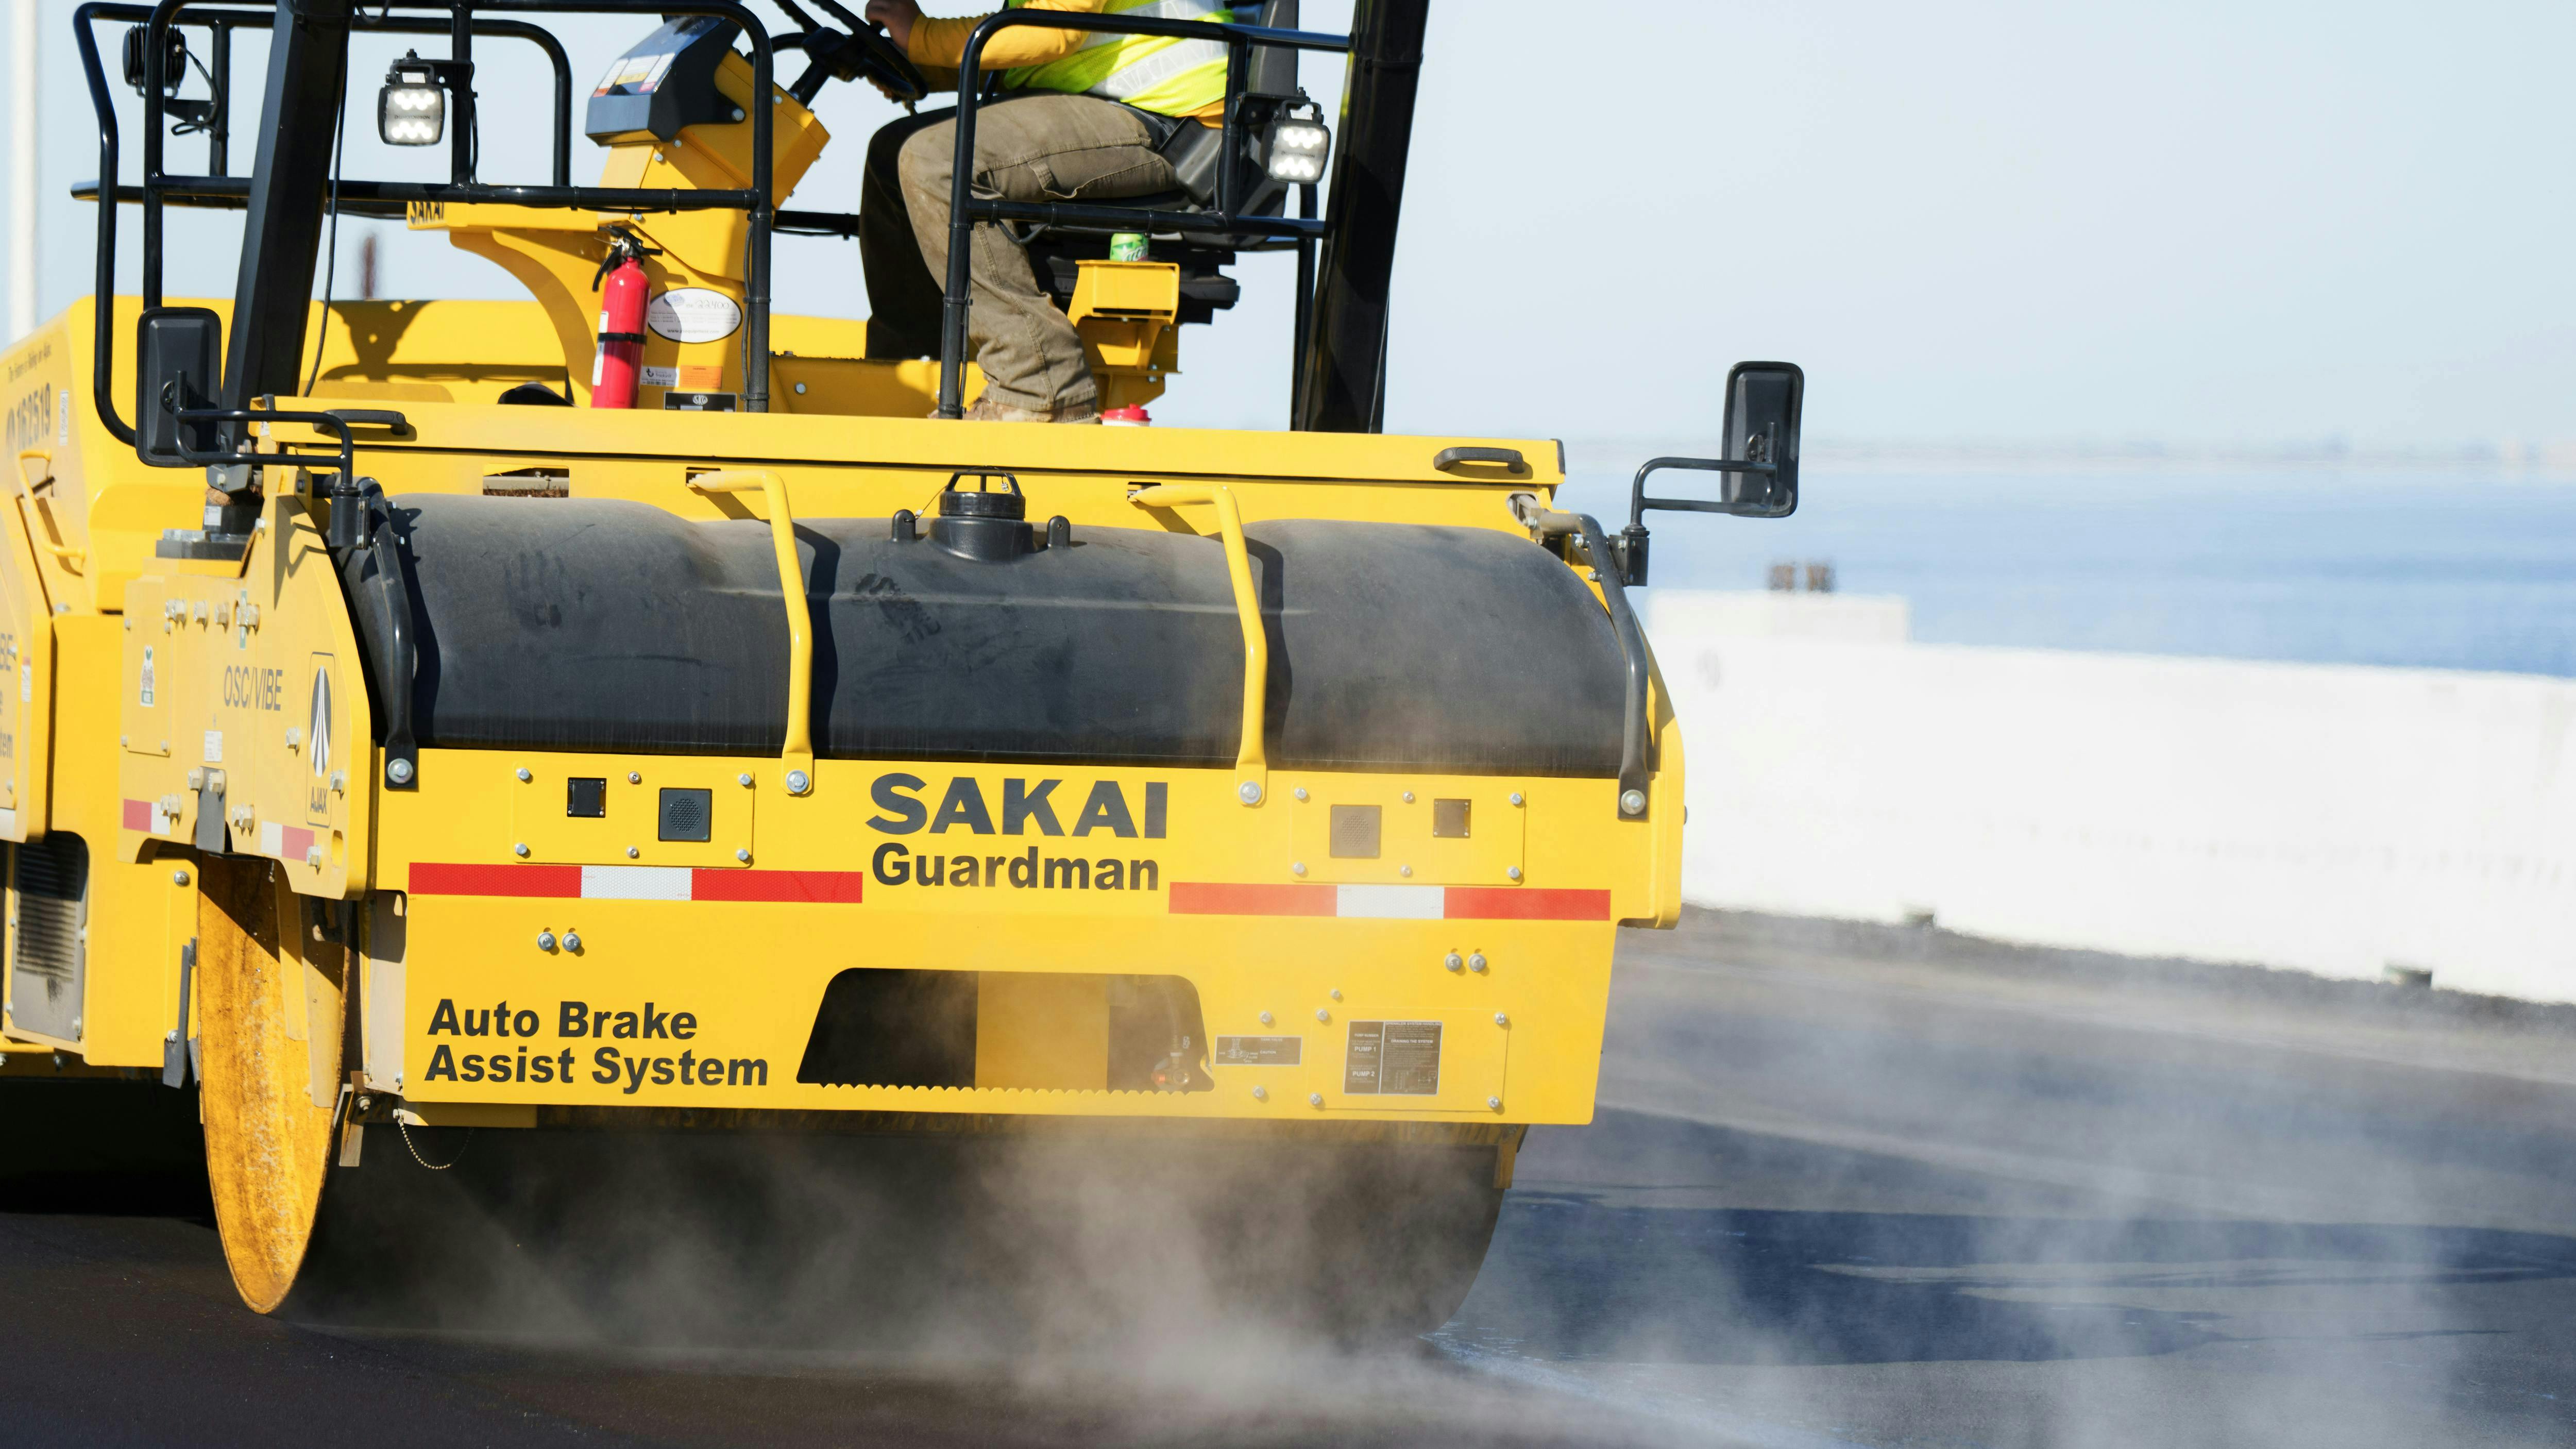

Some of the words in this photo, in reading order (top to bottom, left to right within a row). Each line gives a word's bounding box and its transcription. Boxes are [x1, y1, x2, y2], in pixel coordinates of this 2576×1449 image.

[224, 665, 283, 711] OSC/VIBE
[310, 786, 328, 814] AJAX
[866, 773, 1167, 838] SAKAI
[872, 843, 1158, 890] Guardman
[428, 999, 539, 1037] Auto
[559, 1001, 697, 1039] Brake
[425, 1045, 574, 1083] Assist
[592, 1047, 768, 1094] System
